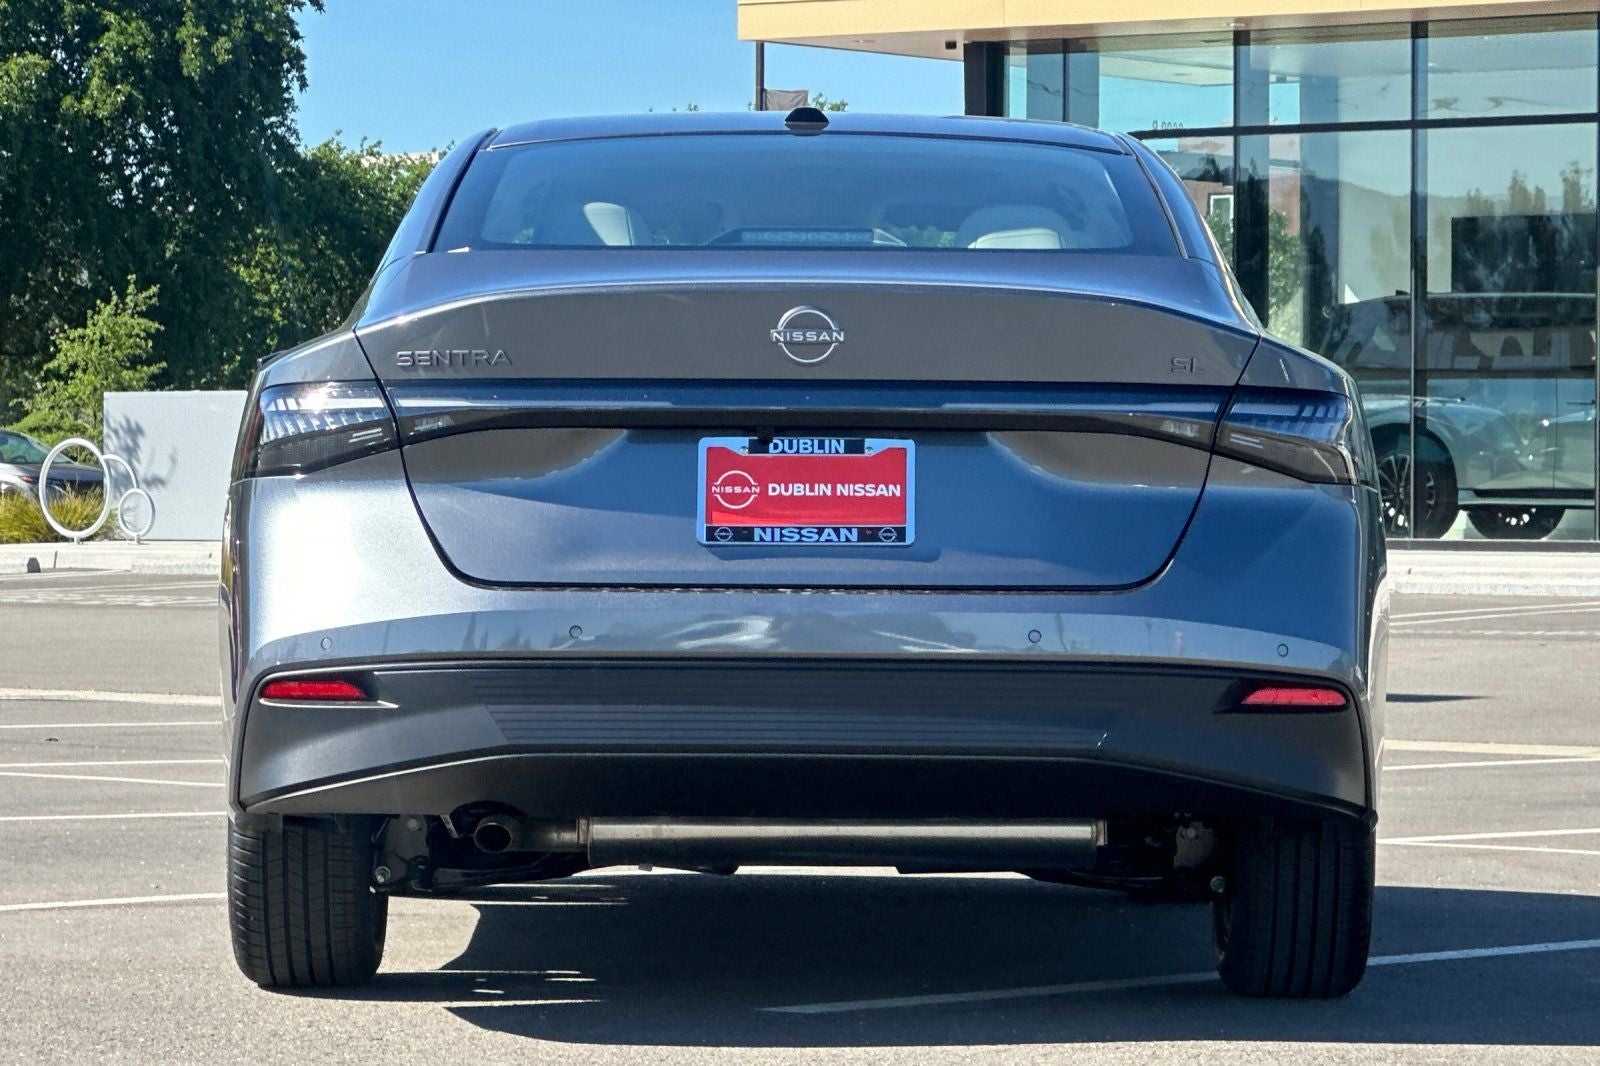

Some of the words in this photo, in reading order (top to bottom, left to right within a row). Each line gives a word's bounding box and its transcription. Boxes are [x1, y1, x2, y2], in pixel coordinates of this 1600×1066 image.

[771, 331, 845, 342] NISSAN
[396, 349, 513, 367] SENTRA
[1170, 357, 1203, 373] SL
[768, 439, 845, 454] DUBLIN
[711, 485, 760, 494] NISSAN
[767, 483, 832, 497] DUBLIN
[836, 483, 901, 497] NISSAN
[753, 527, 858, 542] NISSAN
